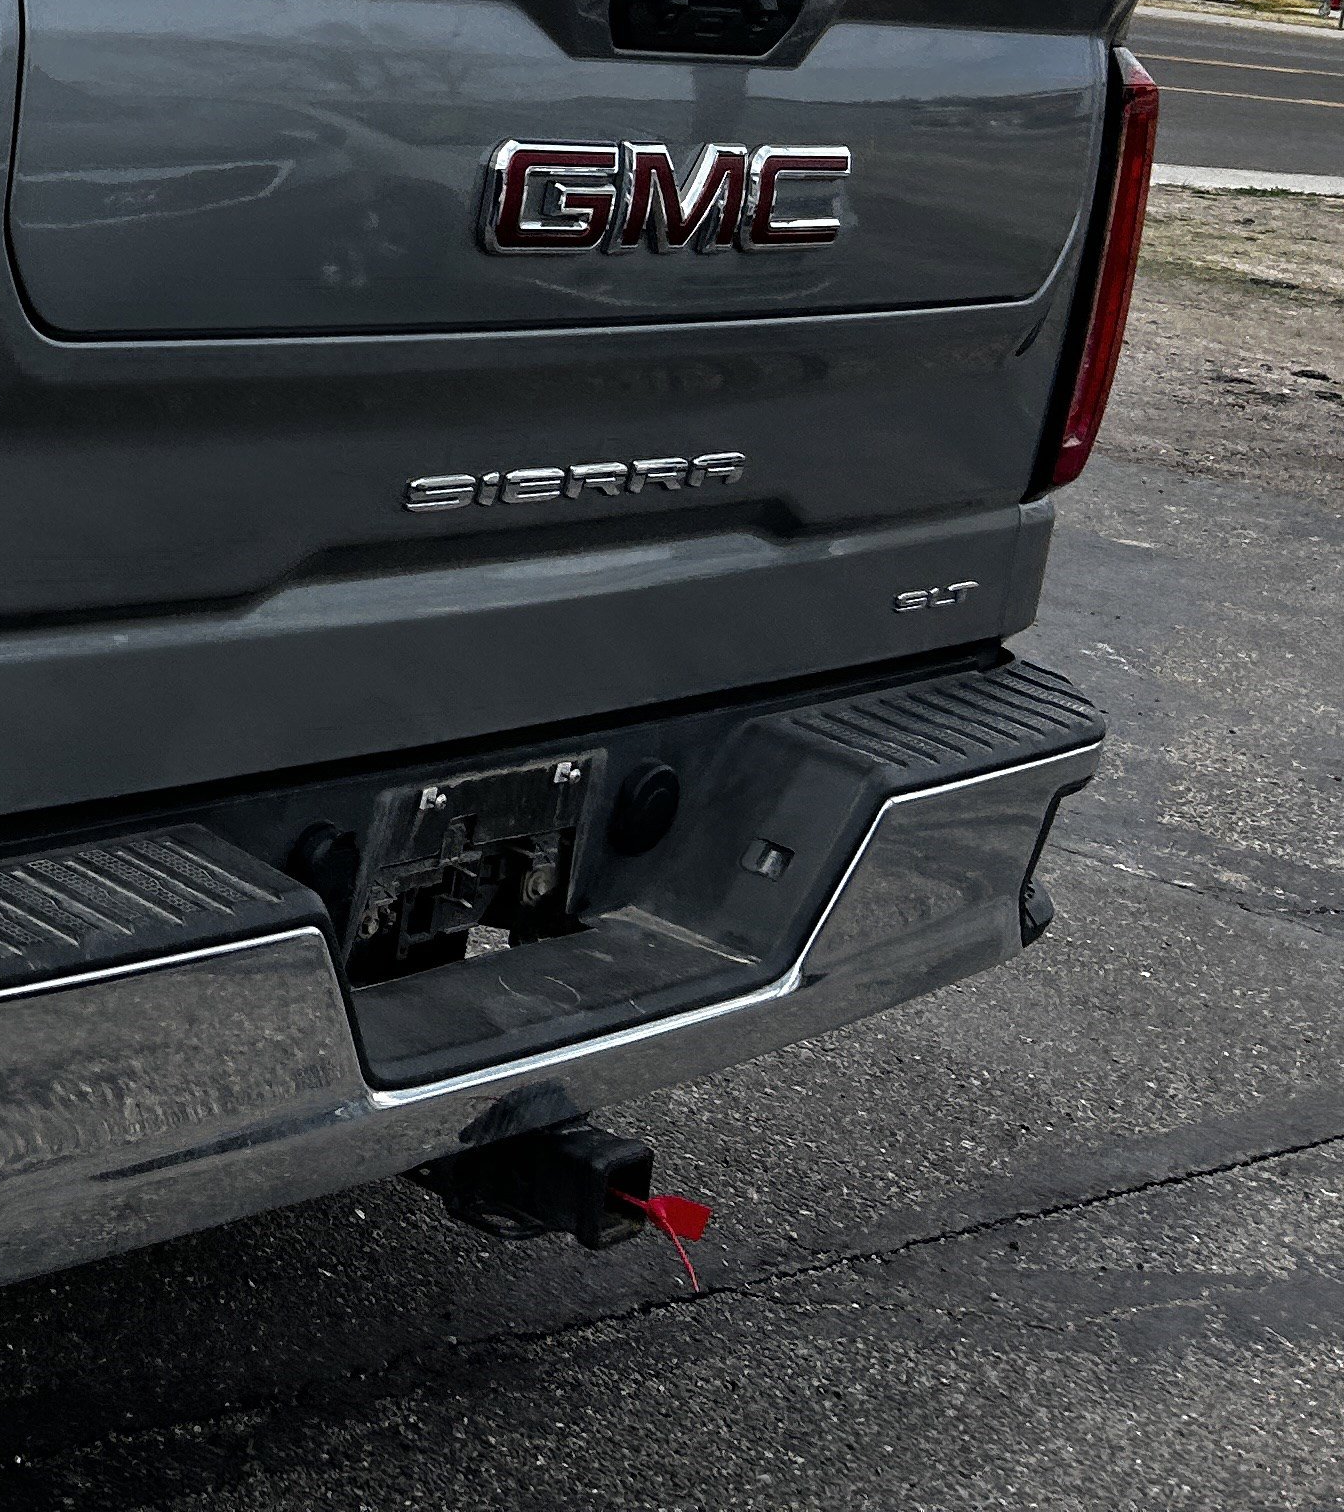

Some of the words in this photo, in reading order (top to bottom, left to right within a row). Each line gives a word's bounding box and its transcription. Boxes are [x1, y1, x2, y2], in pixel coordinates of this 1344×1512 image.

[480, 138, 853, 255] GMC
[406, 450, 747, 512] SIERRA
[894, 580, 980, 611] SLT
